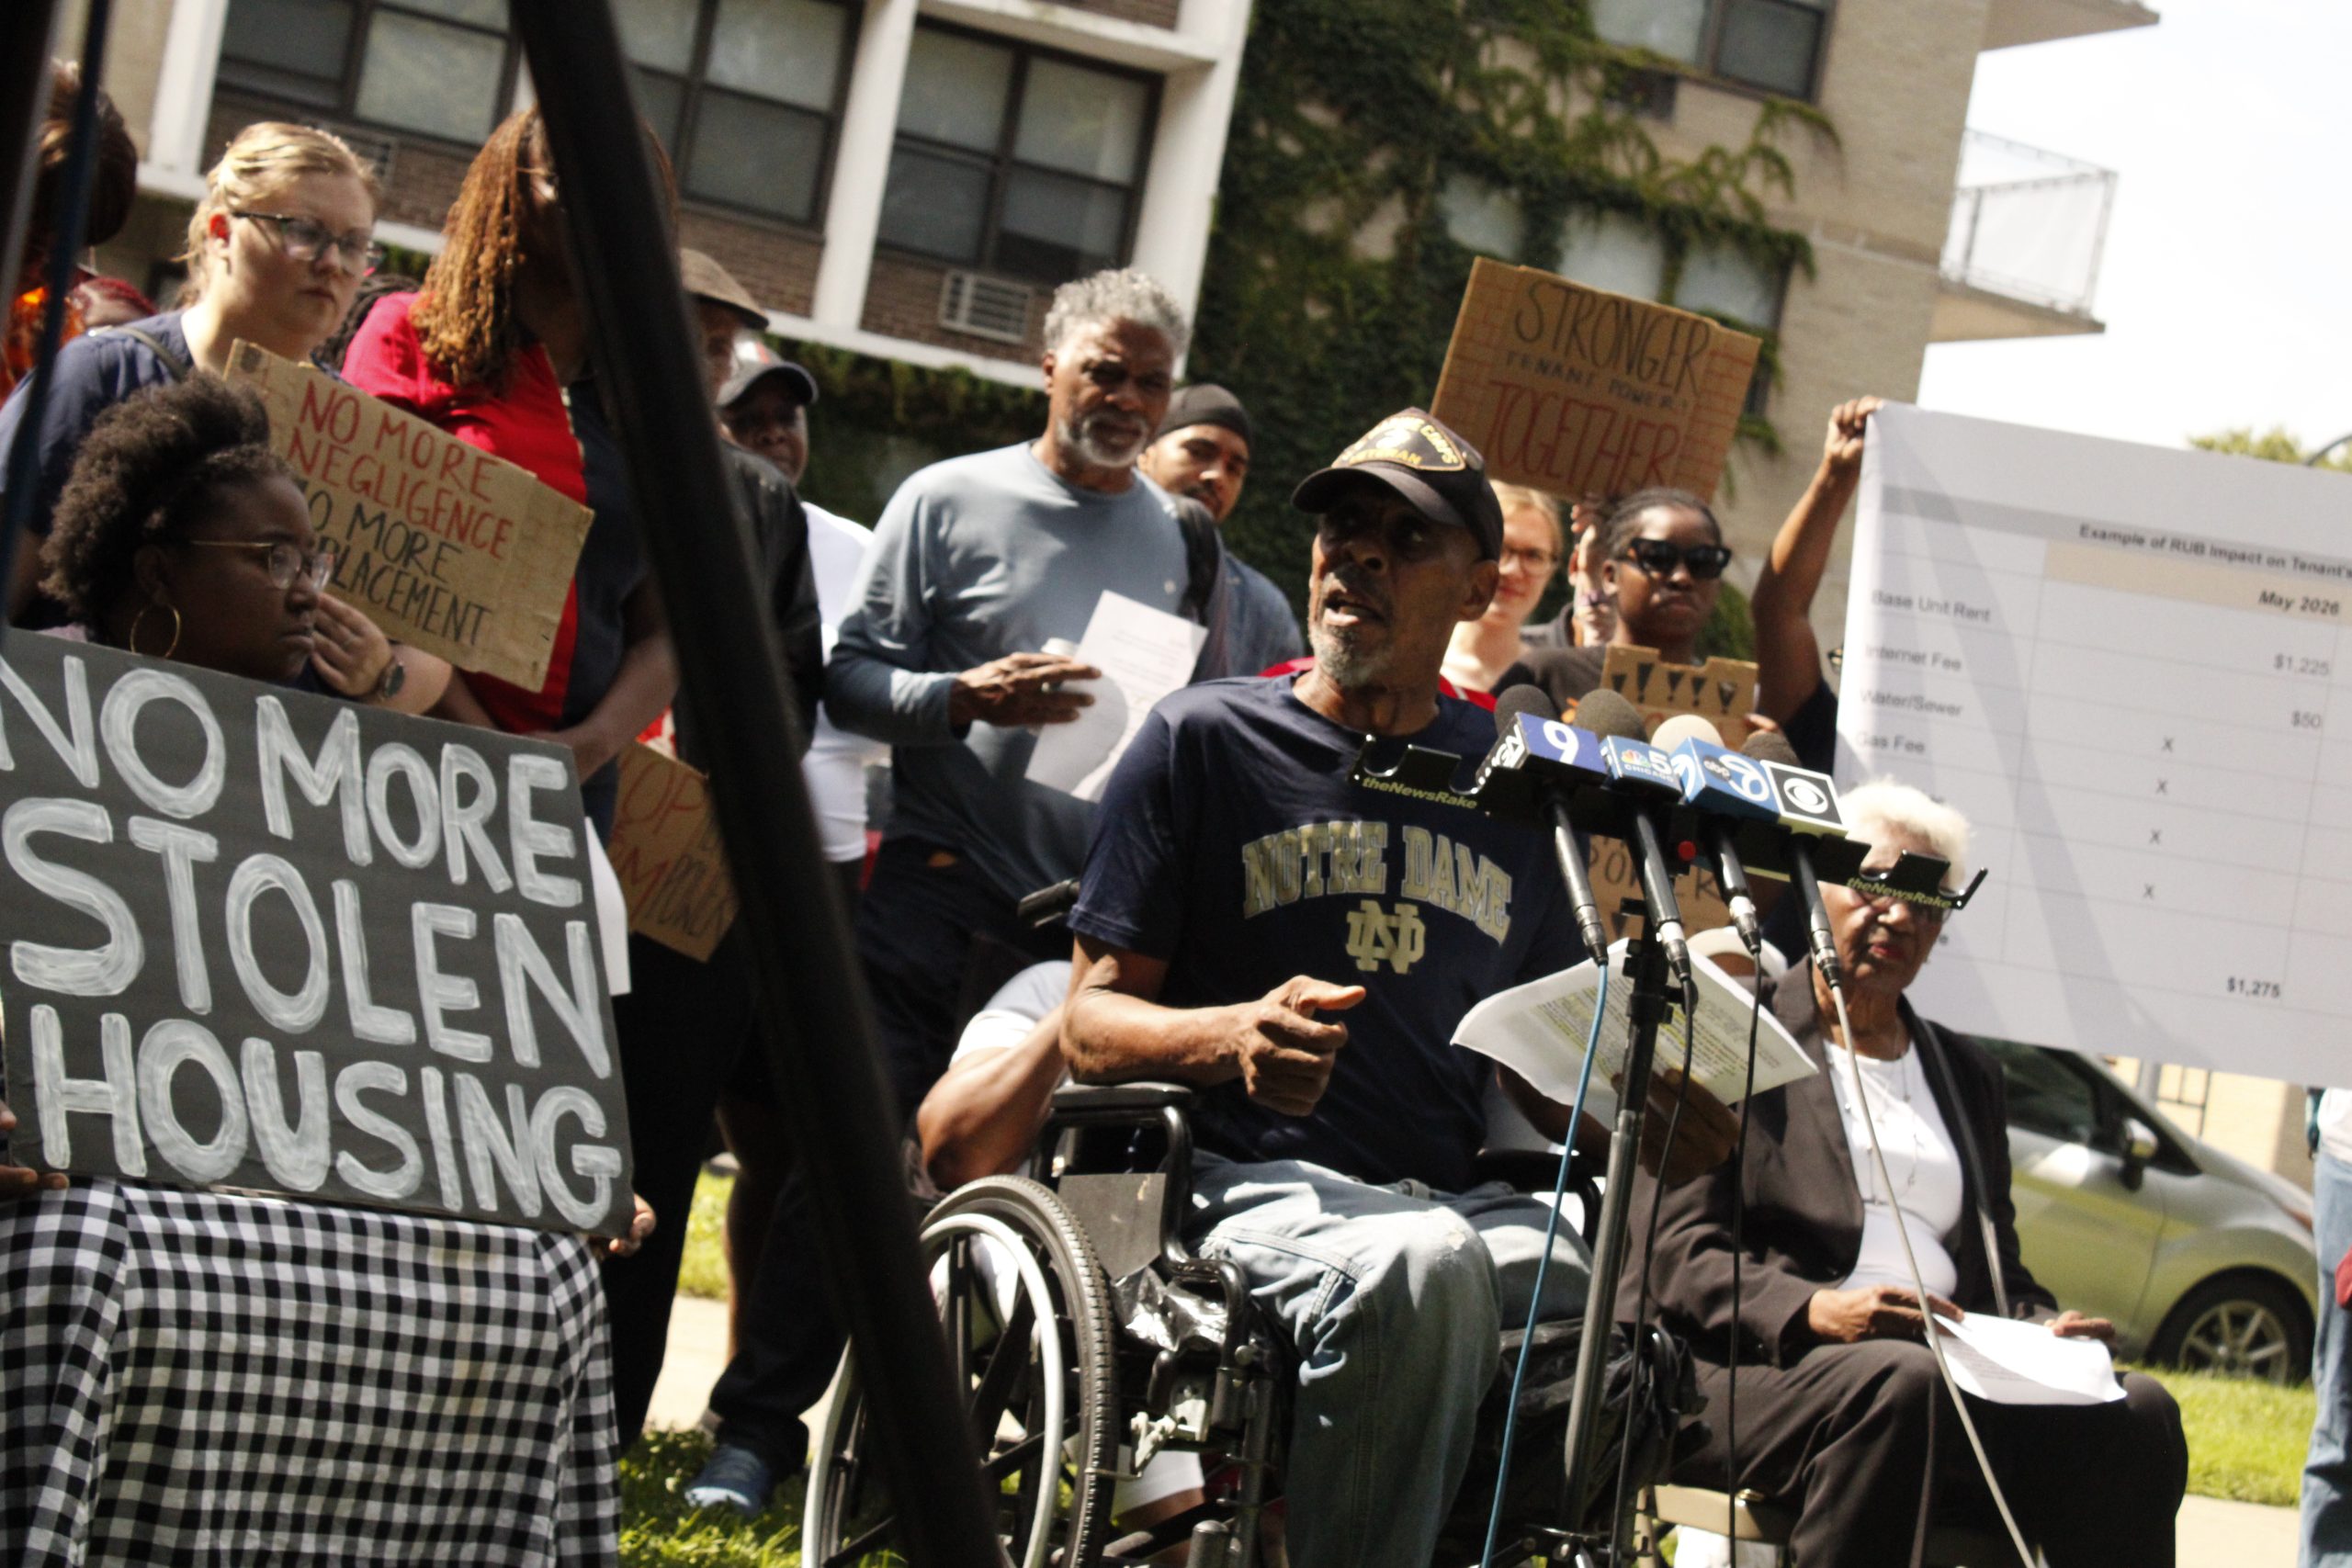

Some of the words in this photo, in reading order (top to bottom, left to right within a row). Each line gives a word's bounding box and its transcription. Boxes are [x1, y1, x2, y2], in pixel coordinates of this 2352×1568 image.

[1514, 279, 1711, 395] STRONGER
[1507, 350, 1596, 388] TENANT
[300, 379, 361, 445] NO
[374, 412, 500, 503] MORE
[1487, 379, 1679, 496] TOGETHER
[287, 425, 514, 560] NEGLIGENCE
[294, 478, 334, 532] O
[346, 502, 464, 583] MORE
[2079, 524, 2145, 547] Example
[2150, 536, 2166, 549] of
[2170, 537, 2206, 556] RUB
[2210, 544, 2263, 565] Impact
[2267, 556, 2287, 569] on
[318, 536, 493, 645] PLACEMENT
[1873, 590, 1913, 610] Base
[1918, 596, 1950, 615] Unit
[1953, 601, 1992, 622] Rent
[2258, 591, 2295, 613] May
[2300, 596, 2340, 616] 2026
[1931, 653, 1962, 671] Fee
[2274, 652, 2330, 677] $1,225
[1860, 690, 1964, 716] Water/Sewer
[2290, 710, 2322, 729] $50
[1543, 719, 1579, 764] 9
[1894, 736, 1927, 754] Fee
[1623, 763, 1675, 784] CHICAGO
[1648, 750, 1673, 775] 5
[1703, 759, 1731, 778] abc
[0, 654, 226, 819] NO
[256, 694, 583, 908] MORE
[1363, 776, 1477, 809] theNewsRake
[1242, 820, 1388, 919] NOTRE
[1401, 825, 1512, 948] DAME
[1846, 876, 1952, 908] theNewsRake
[2, 797, 613, 1079] STOLEN
[2227, 976, 2282, 998] $1,275
[29, 1003, 623, 1229] HOUSING
